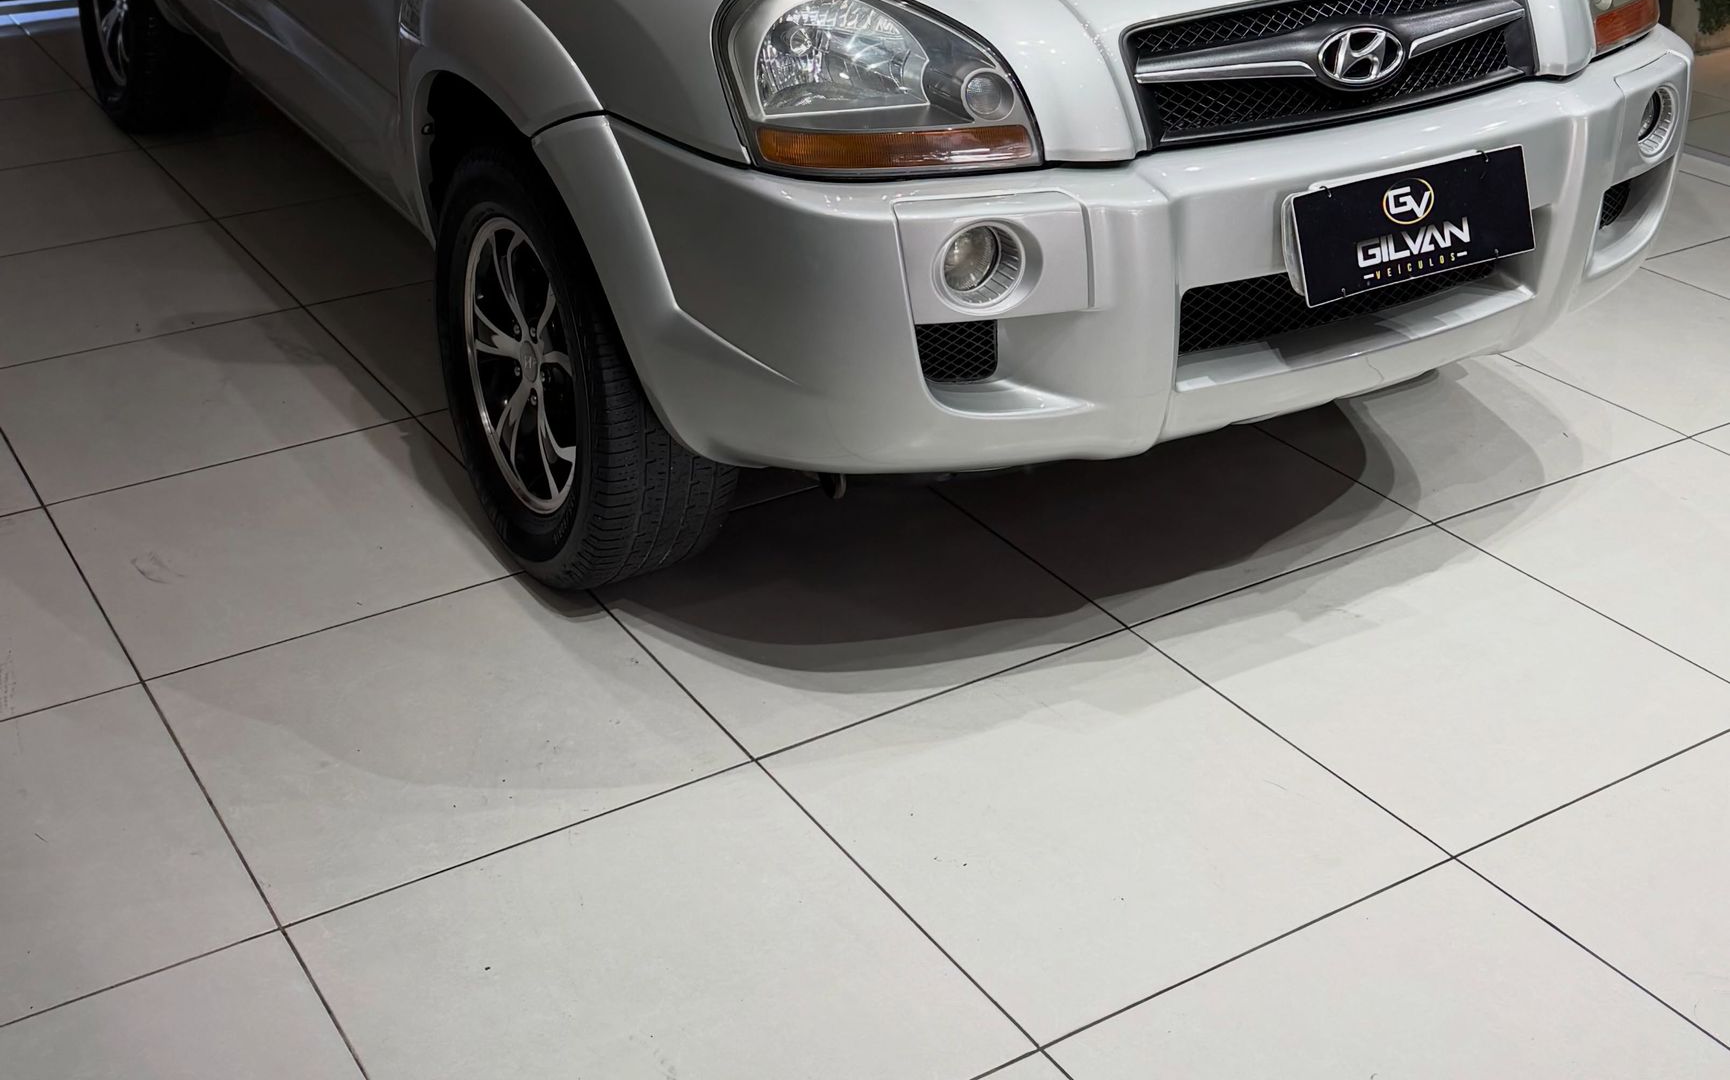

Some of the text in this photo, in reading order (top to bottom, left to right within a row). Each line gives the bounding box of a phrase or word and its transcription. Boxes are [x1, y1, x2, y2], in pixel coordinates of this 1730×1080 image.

[1388, 186, 1433, 218] GV
[1357, 217, 1471, 268] GILVAN
[1375, 252, 1456, 280] VEICULOS
